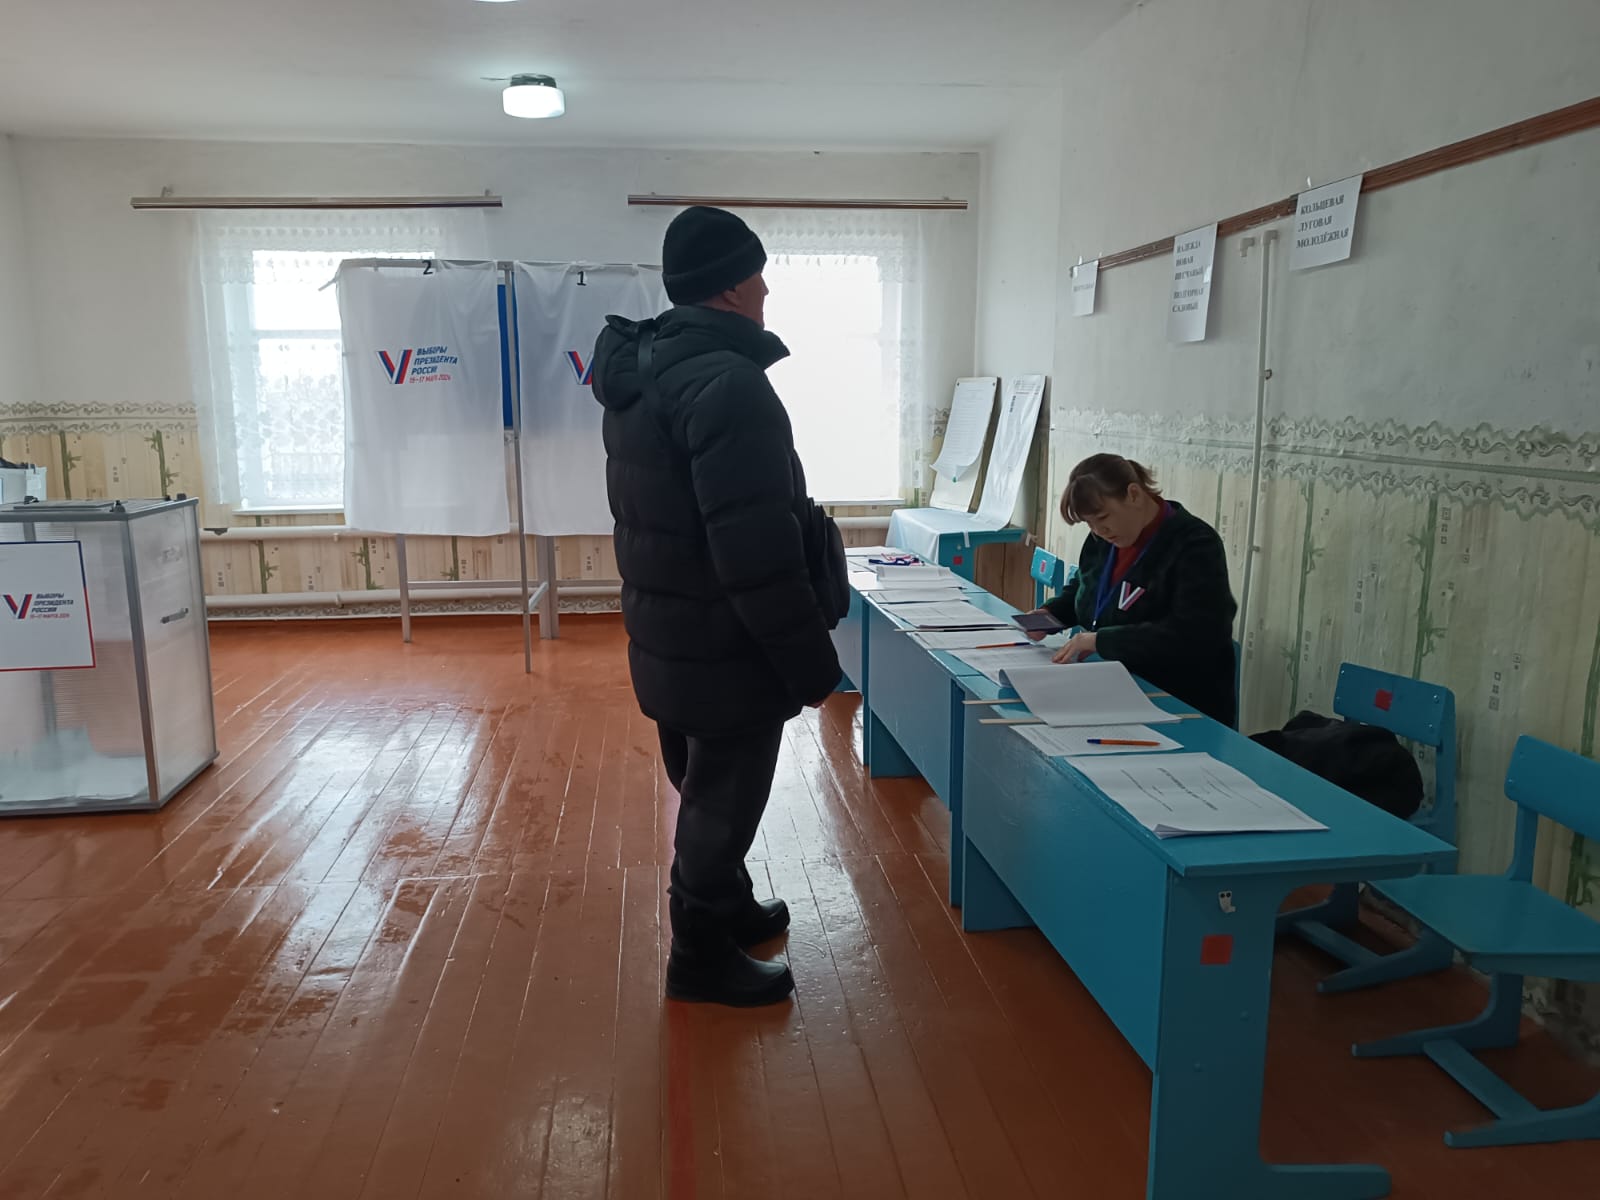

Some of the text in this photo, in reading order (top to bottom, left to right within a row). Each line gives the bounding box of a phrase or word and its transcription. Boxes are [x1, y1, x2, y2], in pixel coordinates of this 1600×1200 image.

[1298, 215, 1333, 233] ЛУГОВАЯ
[1296, 227, 1349, 249] МОЛОДЁЖНАЯ
[422, 259, 433, 275] 2
[576, 271, 587, 287] 1
[416, 346, 448, 356] ВЫБОРЫ
[414, 355, 458, 365] ПРЕЗИДЕНТА
